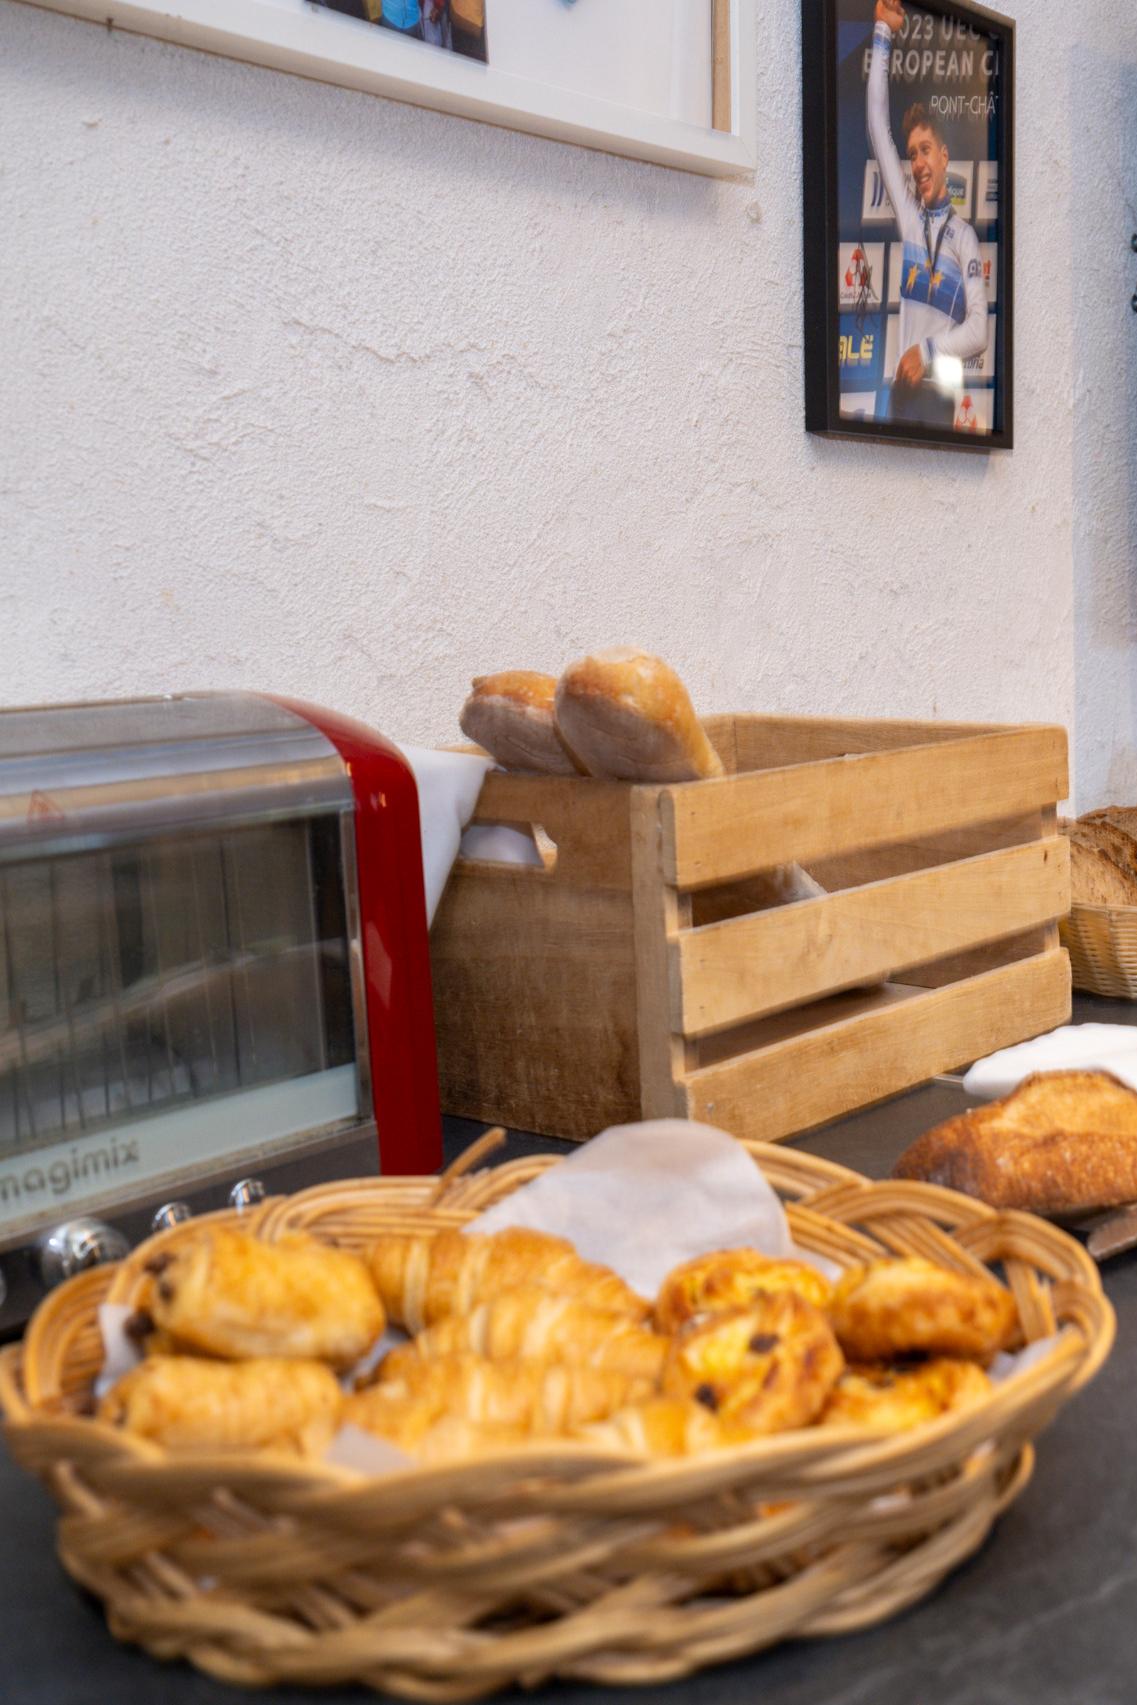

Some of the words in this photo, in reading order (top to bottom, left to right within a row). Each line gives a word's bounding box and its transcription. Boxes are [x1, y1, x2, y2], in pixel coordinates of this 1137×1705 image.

[891, 14, 934, 40] 023
[863, 48, 974, 76] EROPEAN
[931, 91, 998, 114] PONT-CHÂ
